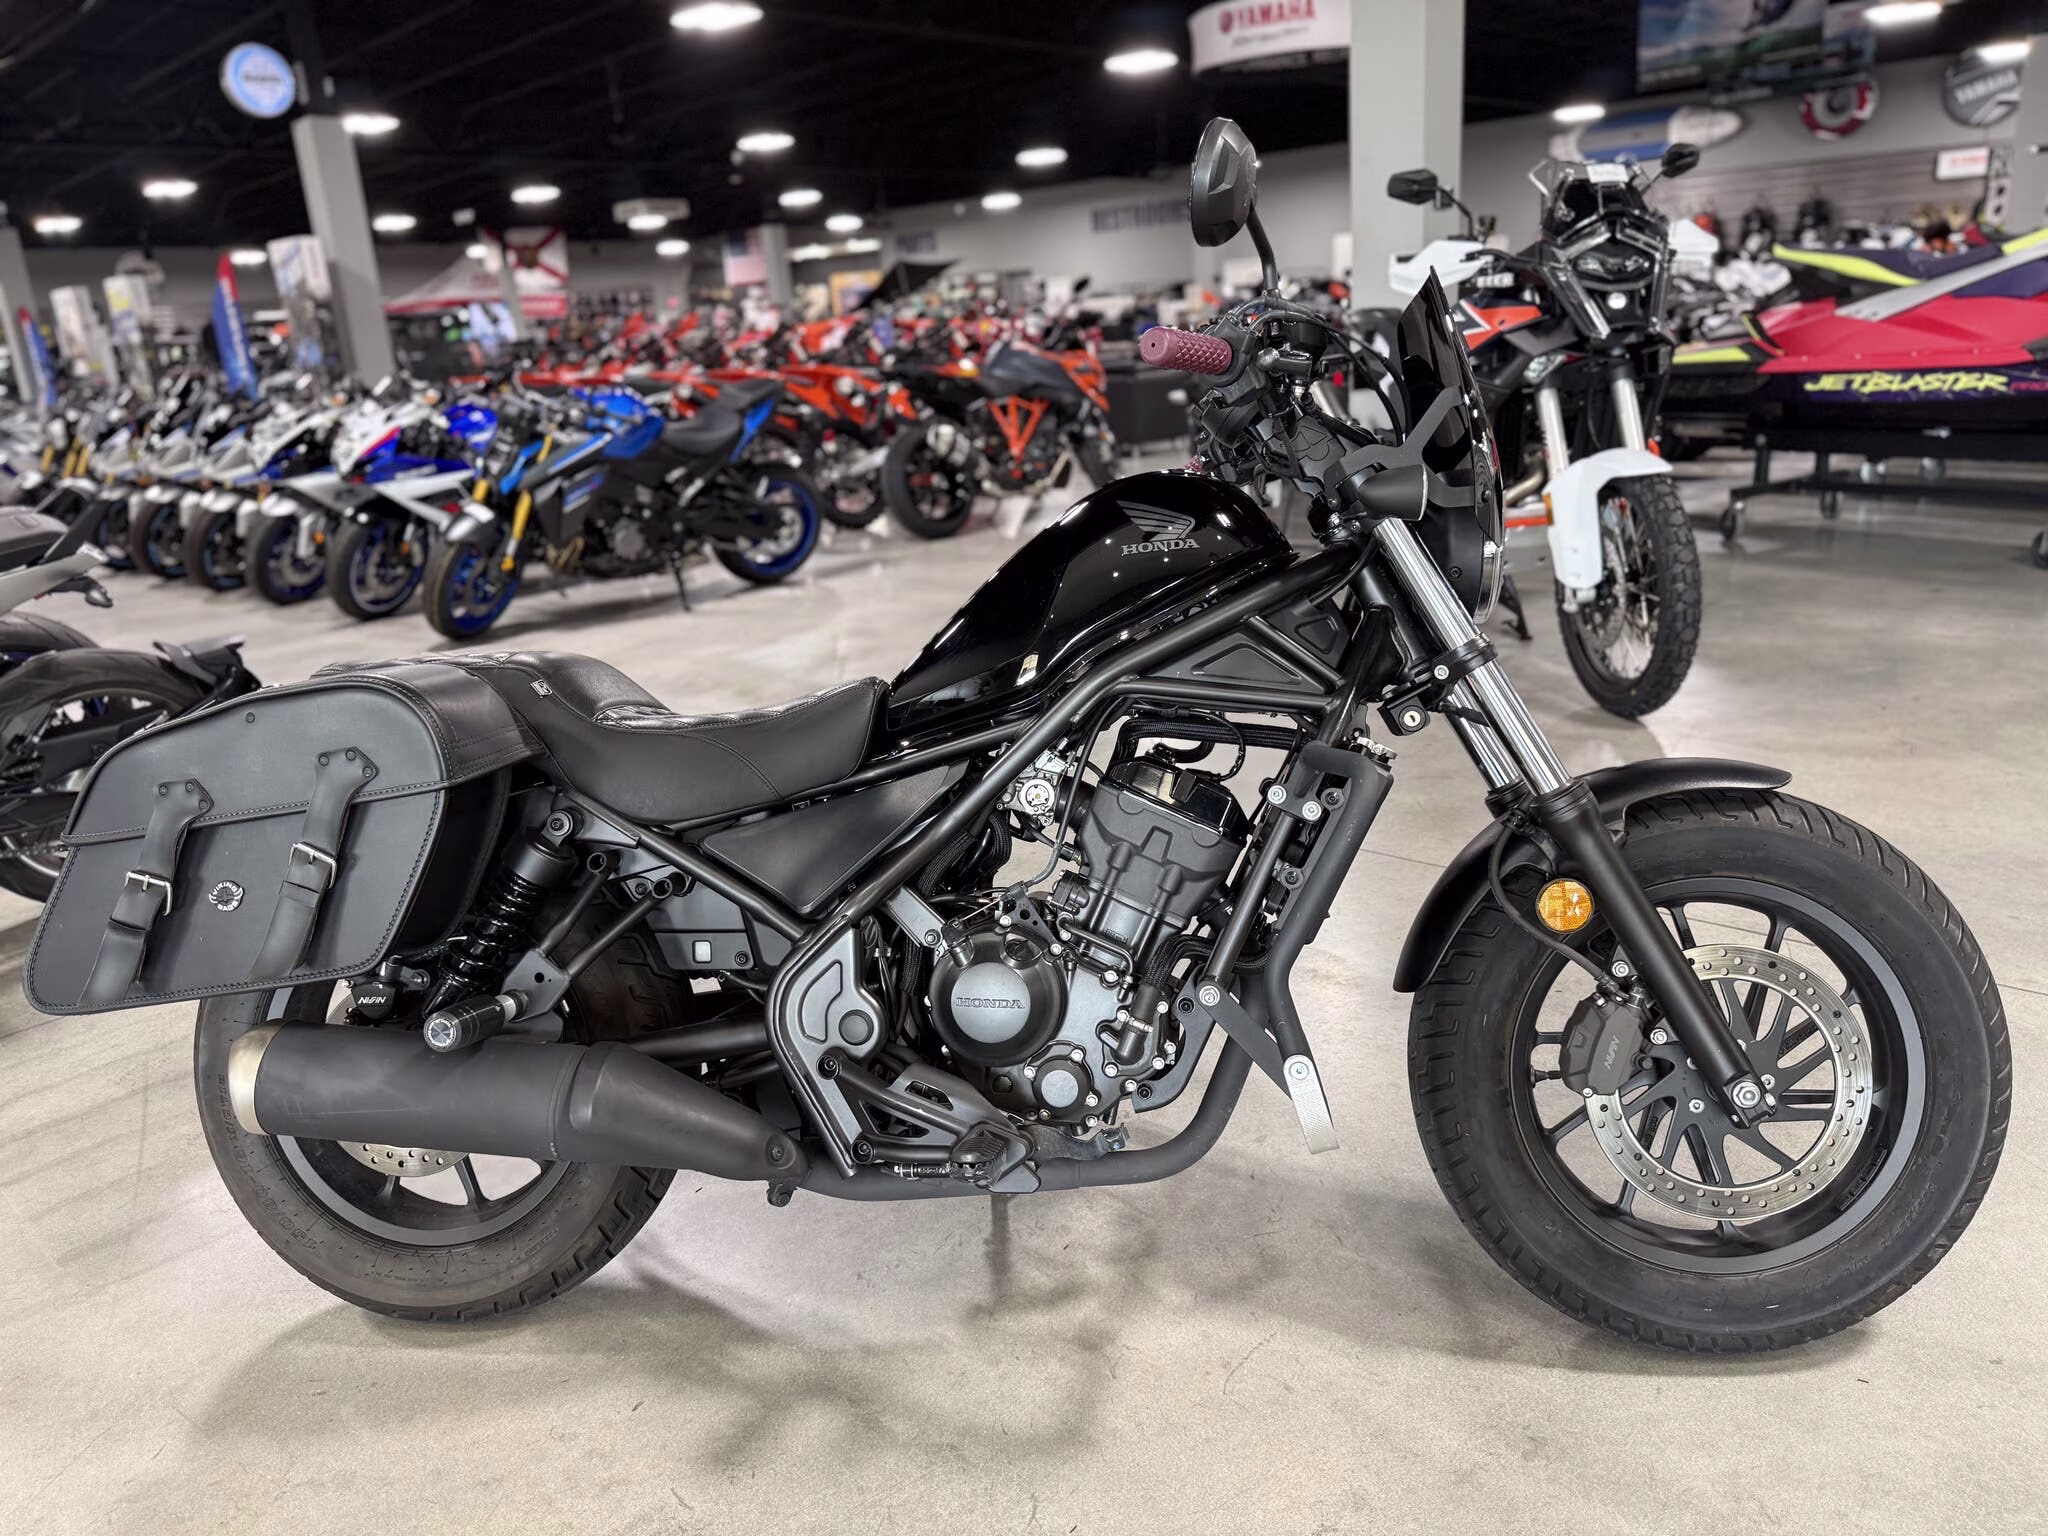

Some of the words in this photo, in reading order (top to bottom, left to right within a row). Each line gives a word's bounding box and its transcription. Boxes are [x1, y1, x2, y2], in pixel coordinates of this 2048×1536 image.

[1238, 0, 1316, 30] YAMAHA
[1121, 539, 1200, 556] HONDA
[213, 881, 238, 895] VIKING
[217, 900, 238, 911] BAGS
[956, 997, 1025, 1009] HONDA
